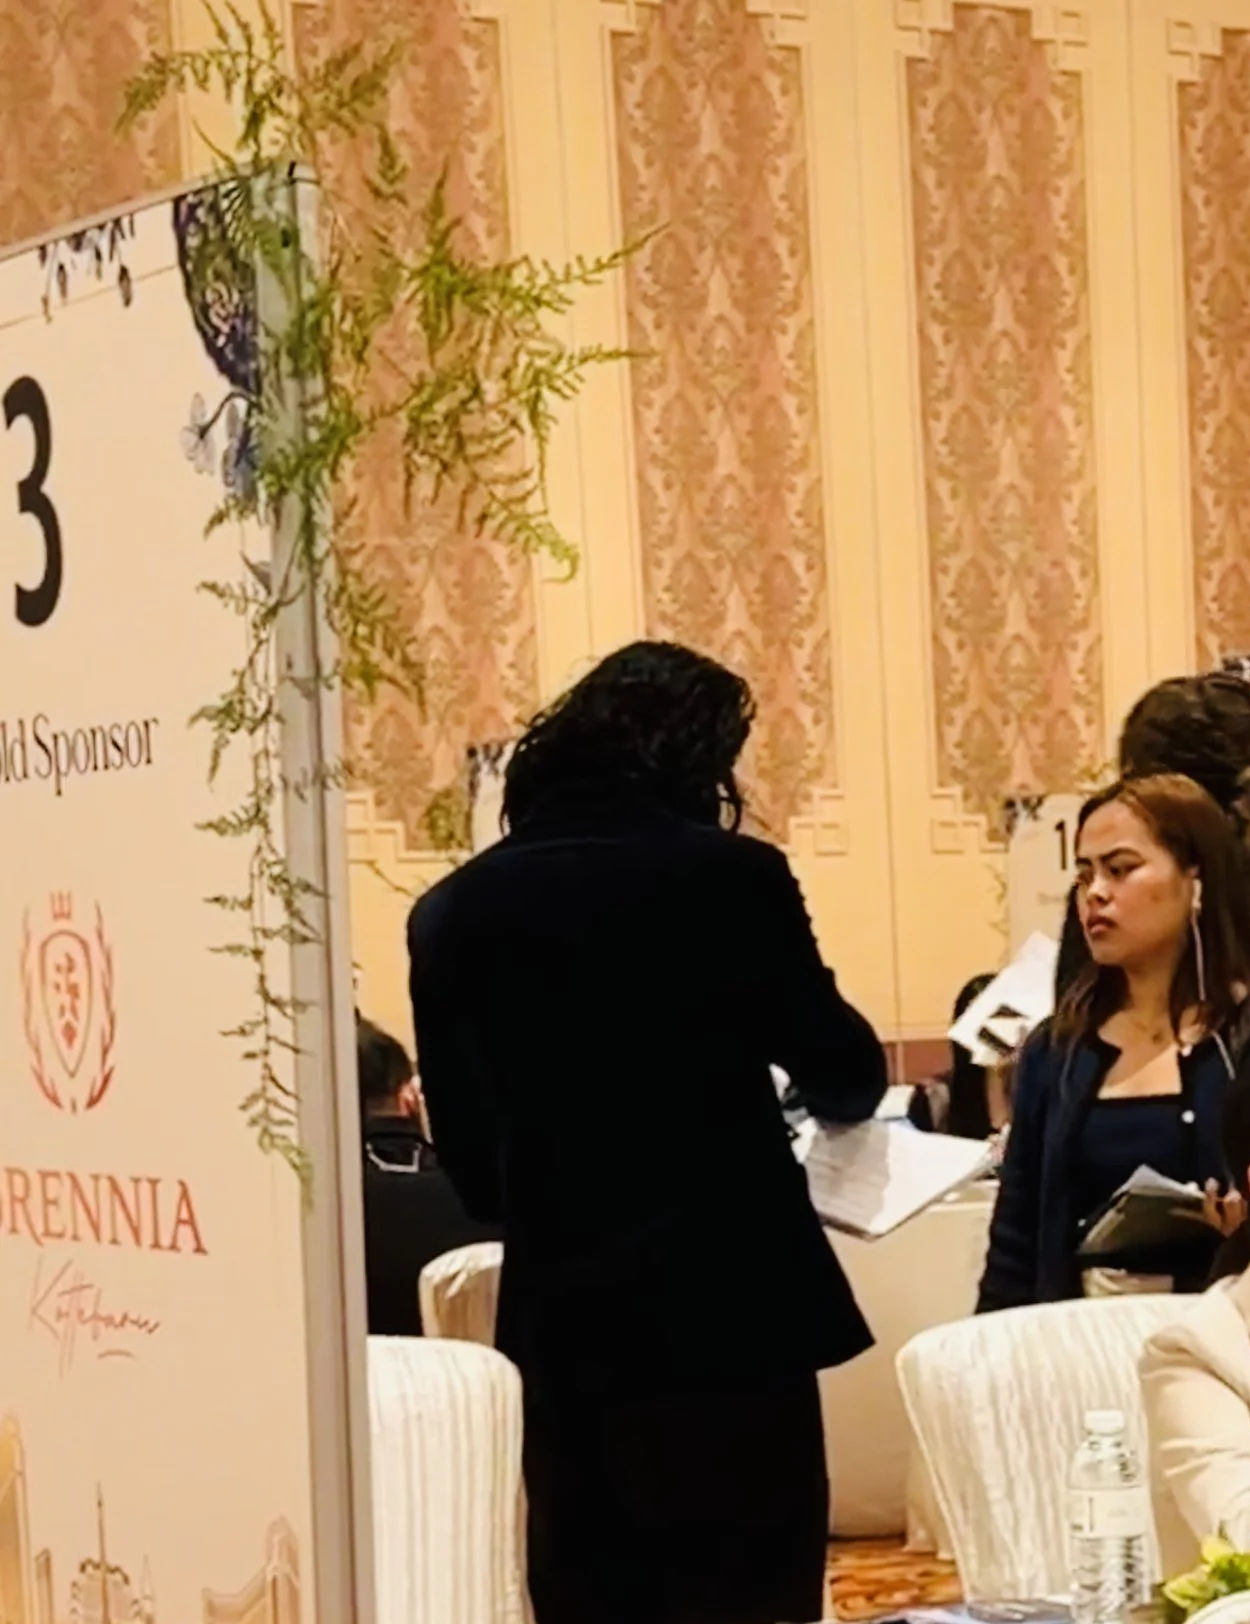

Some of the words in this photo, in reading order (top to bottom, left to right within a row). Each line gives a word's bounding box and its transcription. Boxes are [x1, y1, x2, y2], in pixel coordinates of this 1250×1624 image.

[2, 374, 63, 628] 3
[0, 718, 29, 782] ld
[32, 712, 160, 797] Sponsor
[1054, 819, 1067, 871] 1
[0, 1166, 209, 1256] RENNIA
